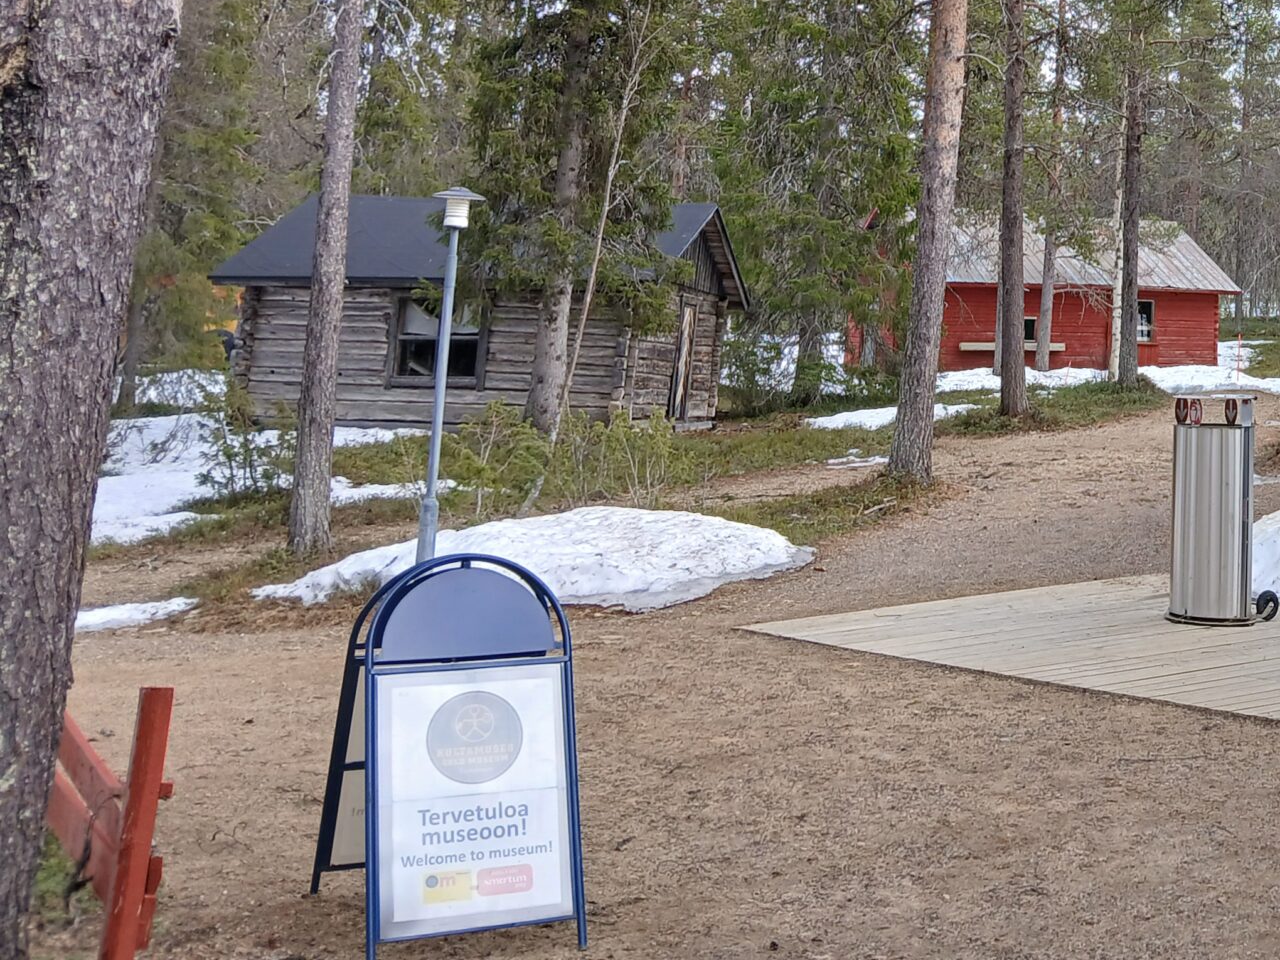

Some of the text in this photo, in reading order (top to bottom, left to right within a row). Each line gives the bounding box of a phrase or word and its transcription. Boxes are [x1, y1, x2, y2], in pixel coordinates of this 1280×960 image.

[417, 801, 529, 826] Tervetuloa
[421, 818, 527, 846] museoon!
[401, 840, 553, 868] Welcome to museum!
